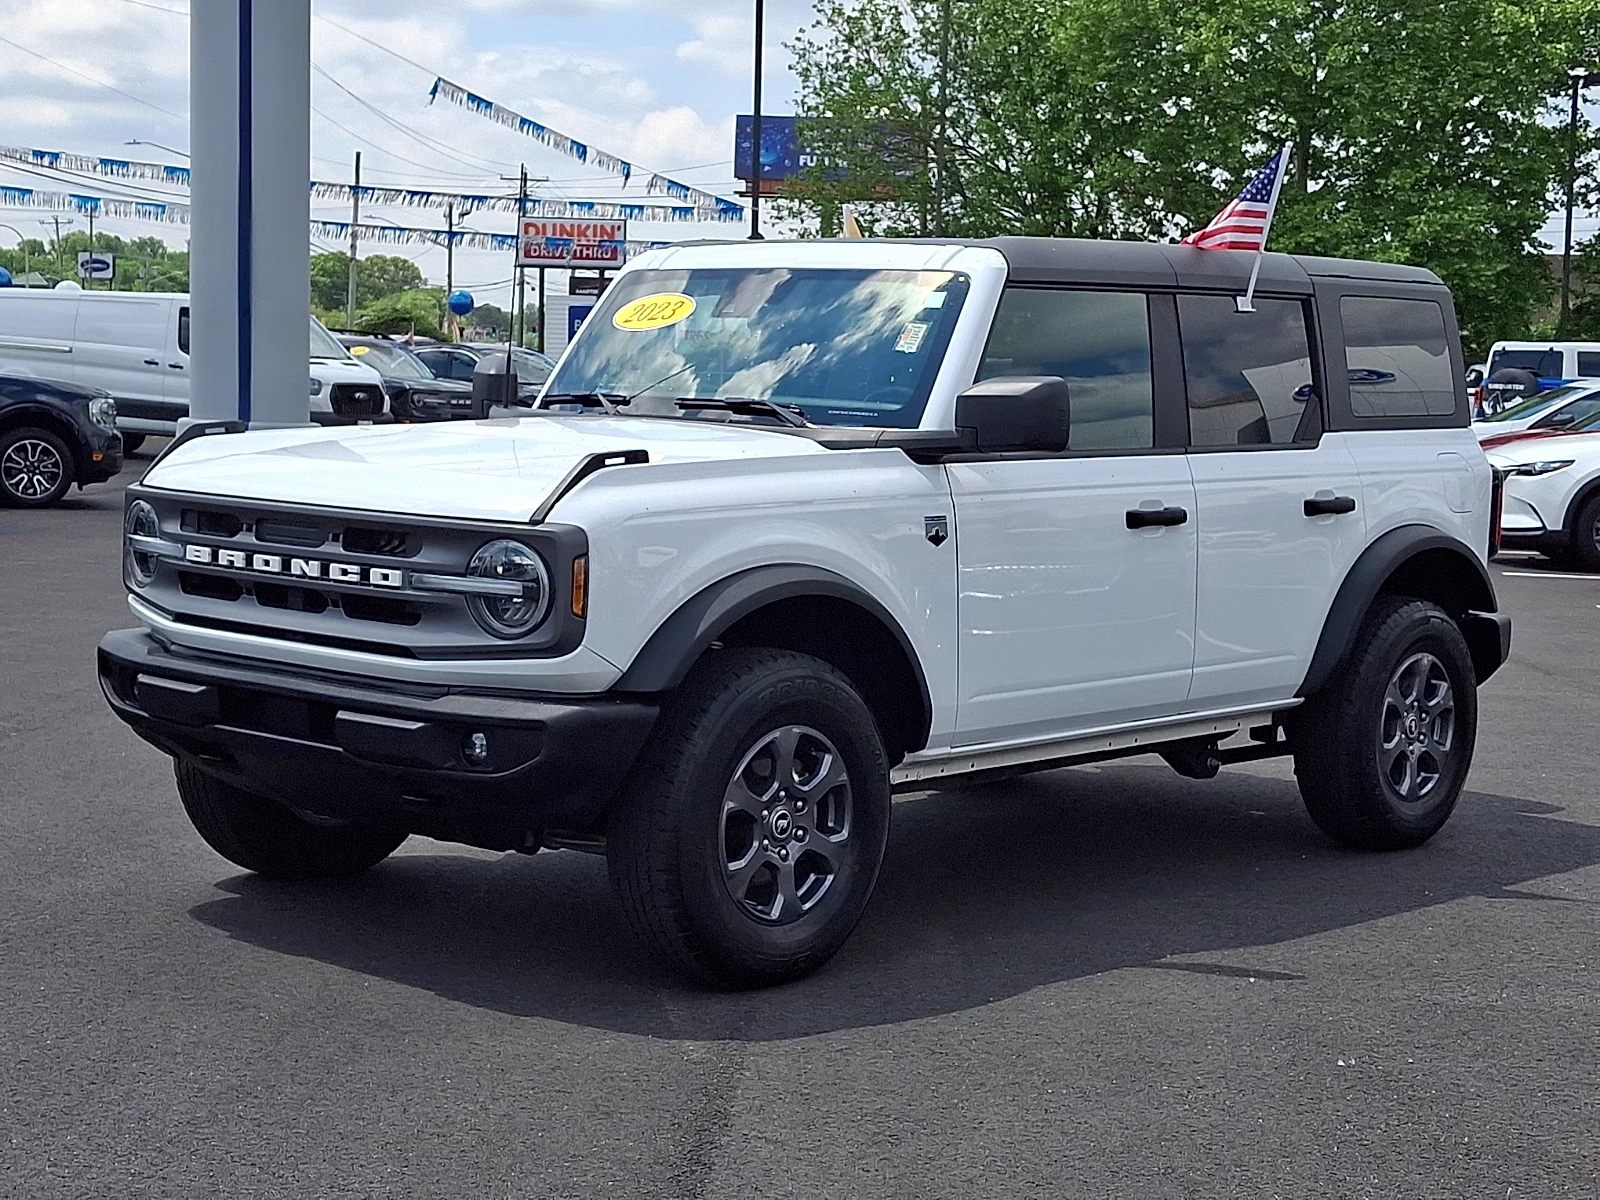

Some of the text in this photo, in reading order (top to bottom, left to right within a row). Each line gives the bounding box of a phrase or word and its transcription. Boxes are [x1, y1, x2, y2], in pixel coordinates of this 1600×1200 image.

[523, 222, 621, 243] DUNKIN'
[623, 301, 685, 323] 2023
[185, 544, 402, 587] BRONCO
